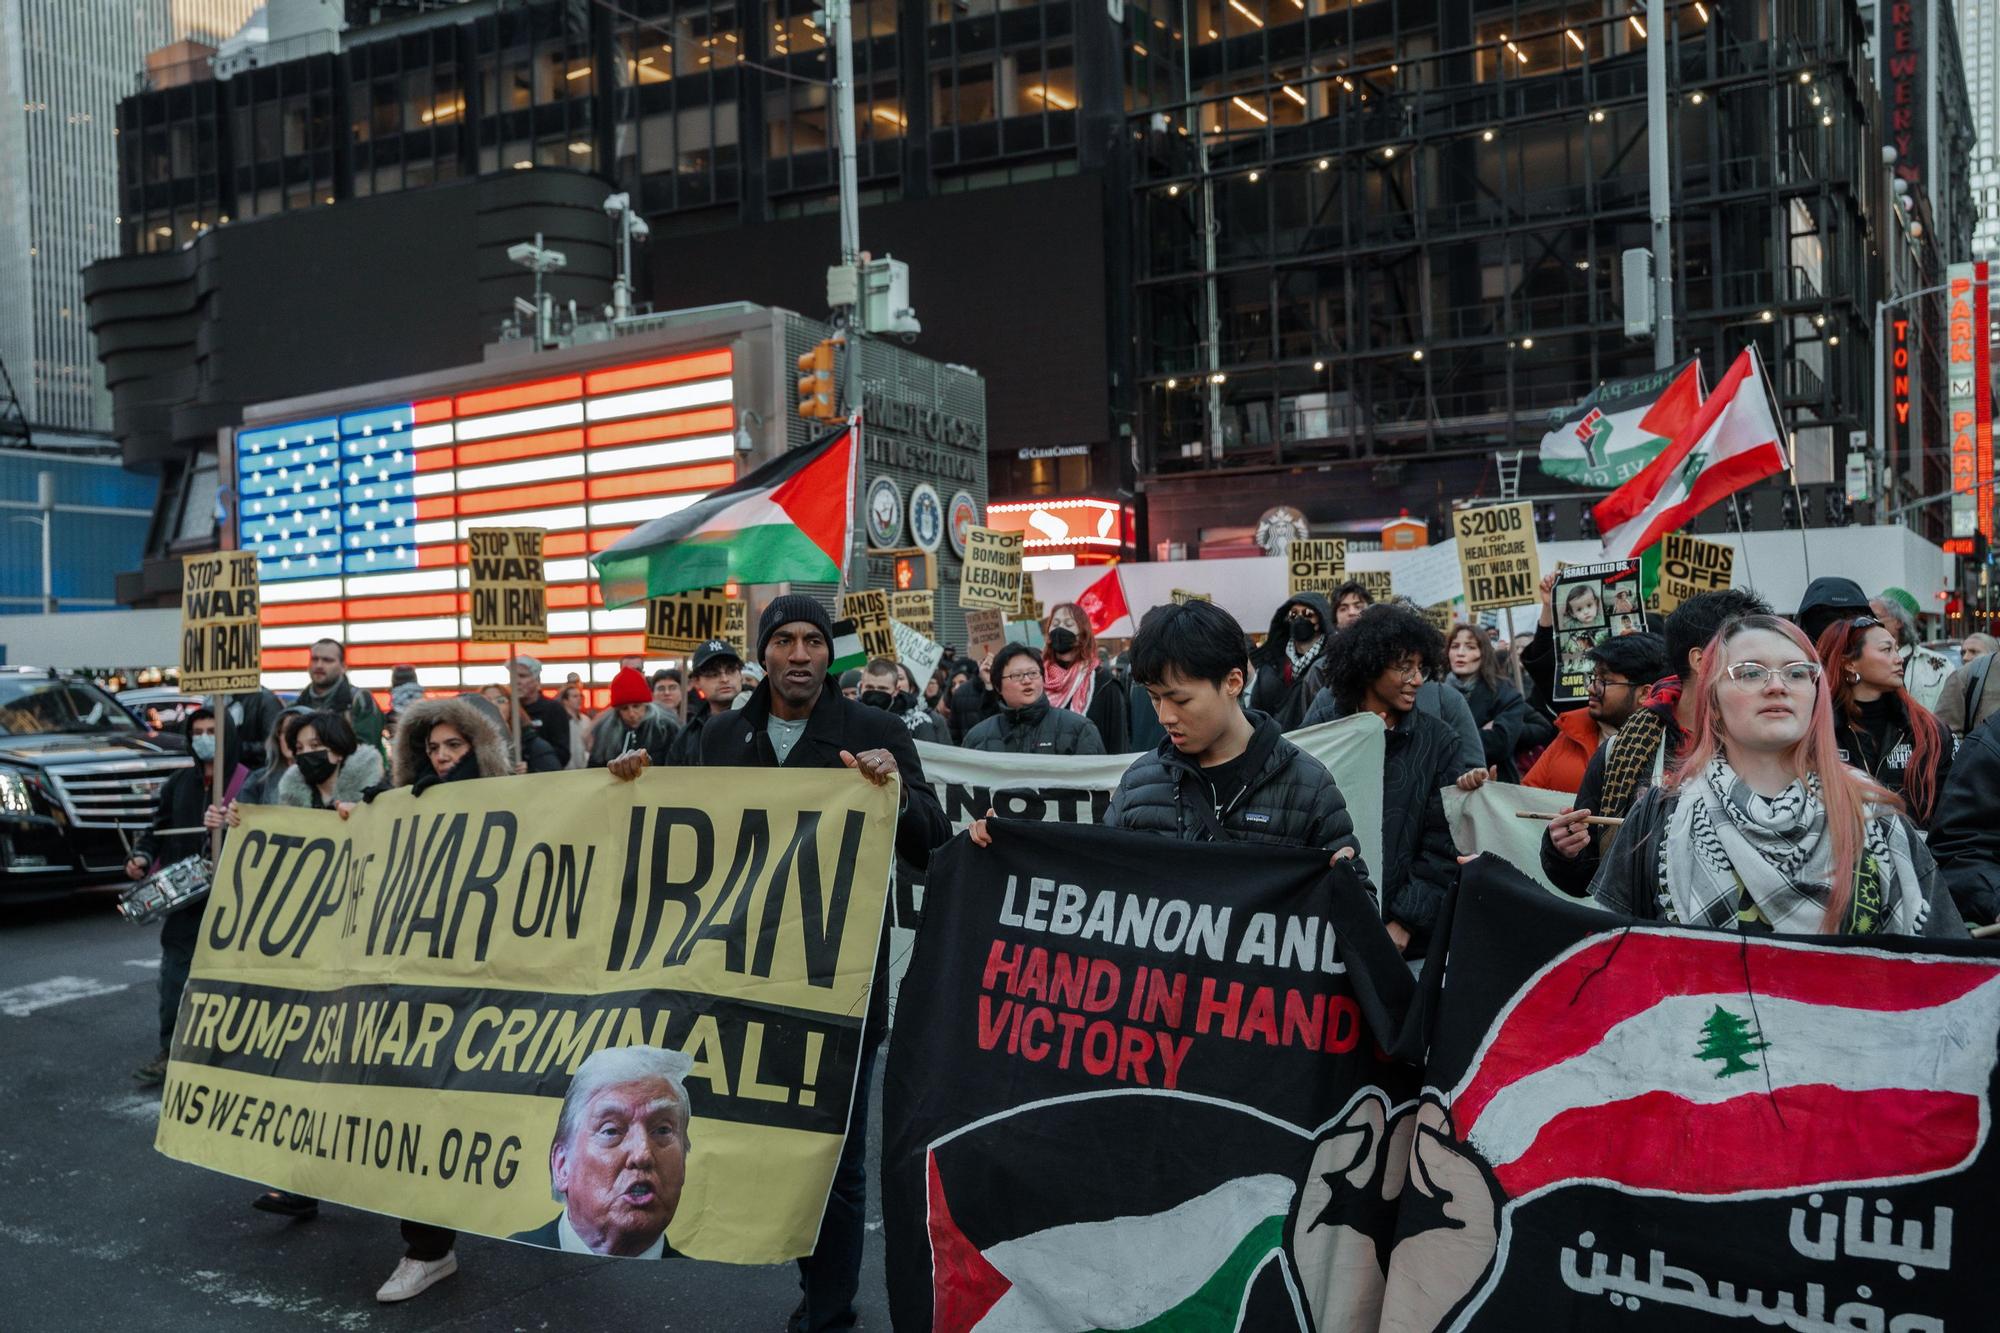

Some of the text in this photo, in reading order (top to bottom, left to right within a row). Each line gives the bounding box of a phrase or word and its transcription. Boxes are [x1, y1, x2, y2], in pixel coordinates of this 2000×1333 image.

[1951, 278, 1972, 364] PARK
[1893, 320, 1910, 425] TONY
[1953, 411, 1974, 496] PARK
[1461, 507, 1522, 537] $200B
[471, 532, 540, 556] STOP THE
[971, 531, 1024, 547] STOP
[1292, 541, 1345, 562] HANDS
[1465, 541, 1525, 560] HEALTHCARE
[1483, 535, 1505, 543] FOR
[1666, 535, 1734, 571] HANDS
[472, 558, 542, 581] WAR
[973, 547, 1021, 566] BOMBING
[1292, 562, 1345, 576] OFF
[1468, 558, 1530, 577] NOT WAR ON
[1563, 566, 1589, 579] ISRAEL
[1590, 562, 1615, 576] KILLED
[187, 556, 256, 591] STOP THE
[965, 566, 1021, 590] LEBANON
[1470, 572, 1533, 602] IRAN!
[1665, 560, 1731, 588] OFF
[186, 589, 257, 620] WAR
[474, 588, 545, 626] ON IRAN!
[895, 594, 933, 605] STOP
[968, 586, 1017, 602] NOW!
[648, 599, 723, 640] IRAN!
[184, 623, 258, 673] ON IRAN!
[862, 629, 894, 656] AN!
[182, 675, 257, 691] PSLWEB.ORG
[1561, 674, 1584, 686] SAVE
[209, 829, 353, 959] STOP
[365, 810, 518, 962] WAR
[512, 842, 596, 940] ON
[606, 806, 866, 990] IRAN
[999, 874, 1232, 962] LEBANON
[981, 939, 1361, 1055] HAND IN HAND
[182, 992, 312, 1060] TRUMP
[350, 1001, 455, 1068] WAR
[454, 1006, 825, 1107] CRIMINAL!
[977, 994, 1196, 1089] VICTORY
[1789, 1193, 1954, 1280] لبنان
